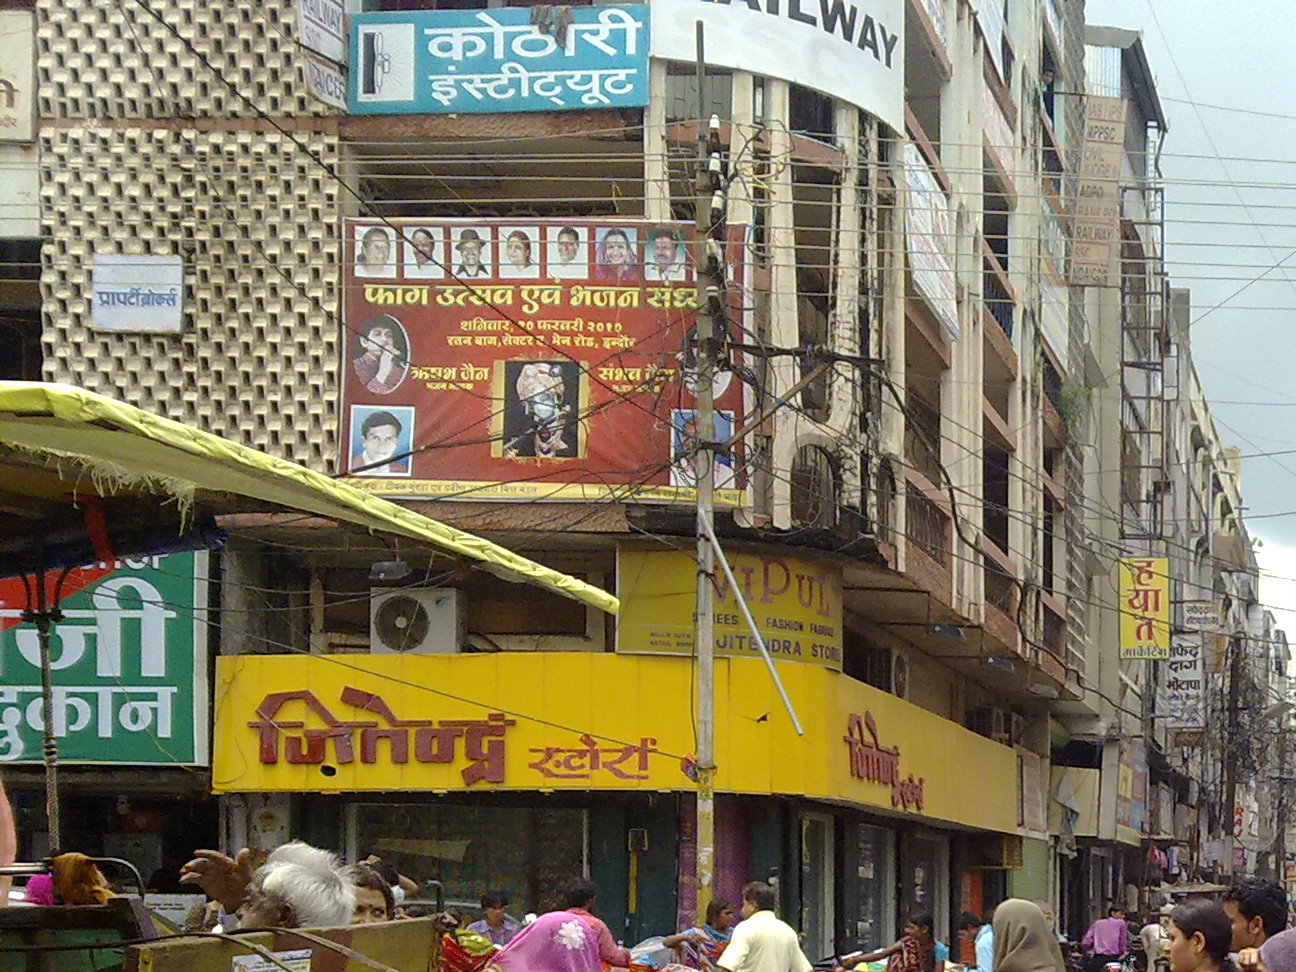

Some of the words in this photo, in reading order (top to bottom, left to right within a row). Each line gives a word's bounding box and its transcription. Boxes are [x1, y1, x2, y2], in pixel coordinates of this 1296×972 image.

[424, 9, 642, 60] कोठारी
[429, 62, 637, 104] इंस्टीट्यूट
[363, 284, 430, 306] फाग
[436, 285, 514, 306] उत्सव
[520, 277, 563, 314] एवं
[570, 285, 640, 308] भजन
[714, 557, 830, 617] VIPUL
[767, 617, 804, 632] FASHION
[716, 634, 802, 656] JITENDRA
[1169, 660, 1198, 672] दाग
